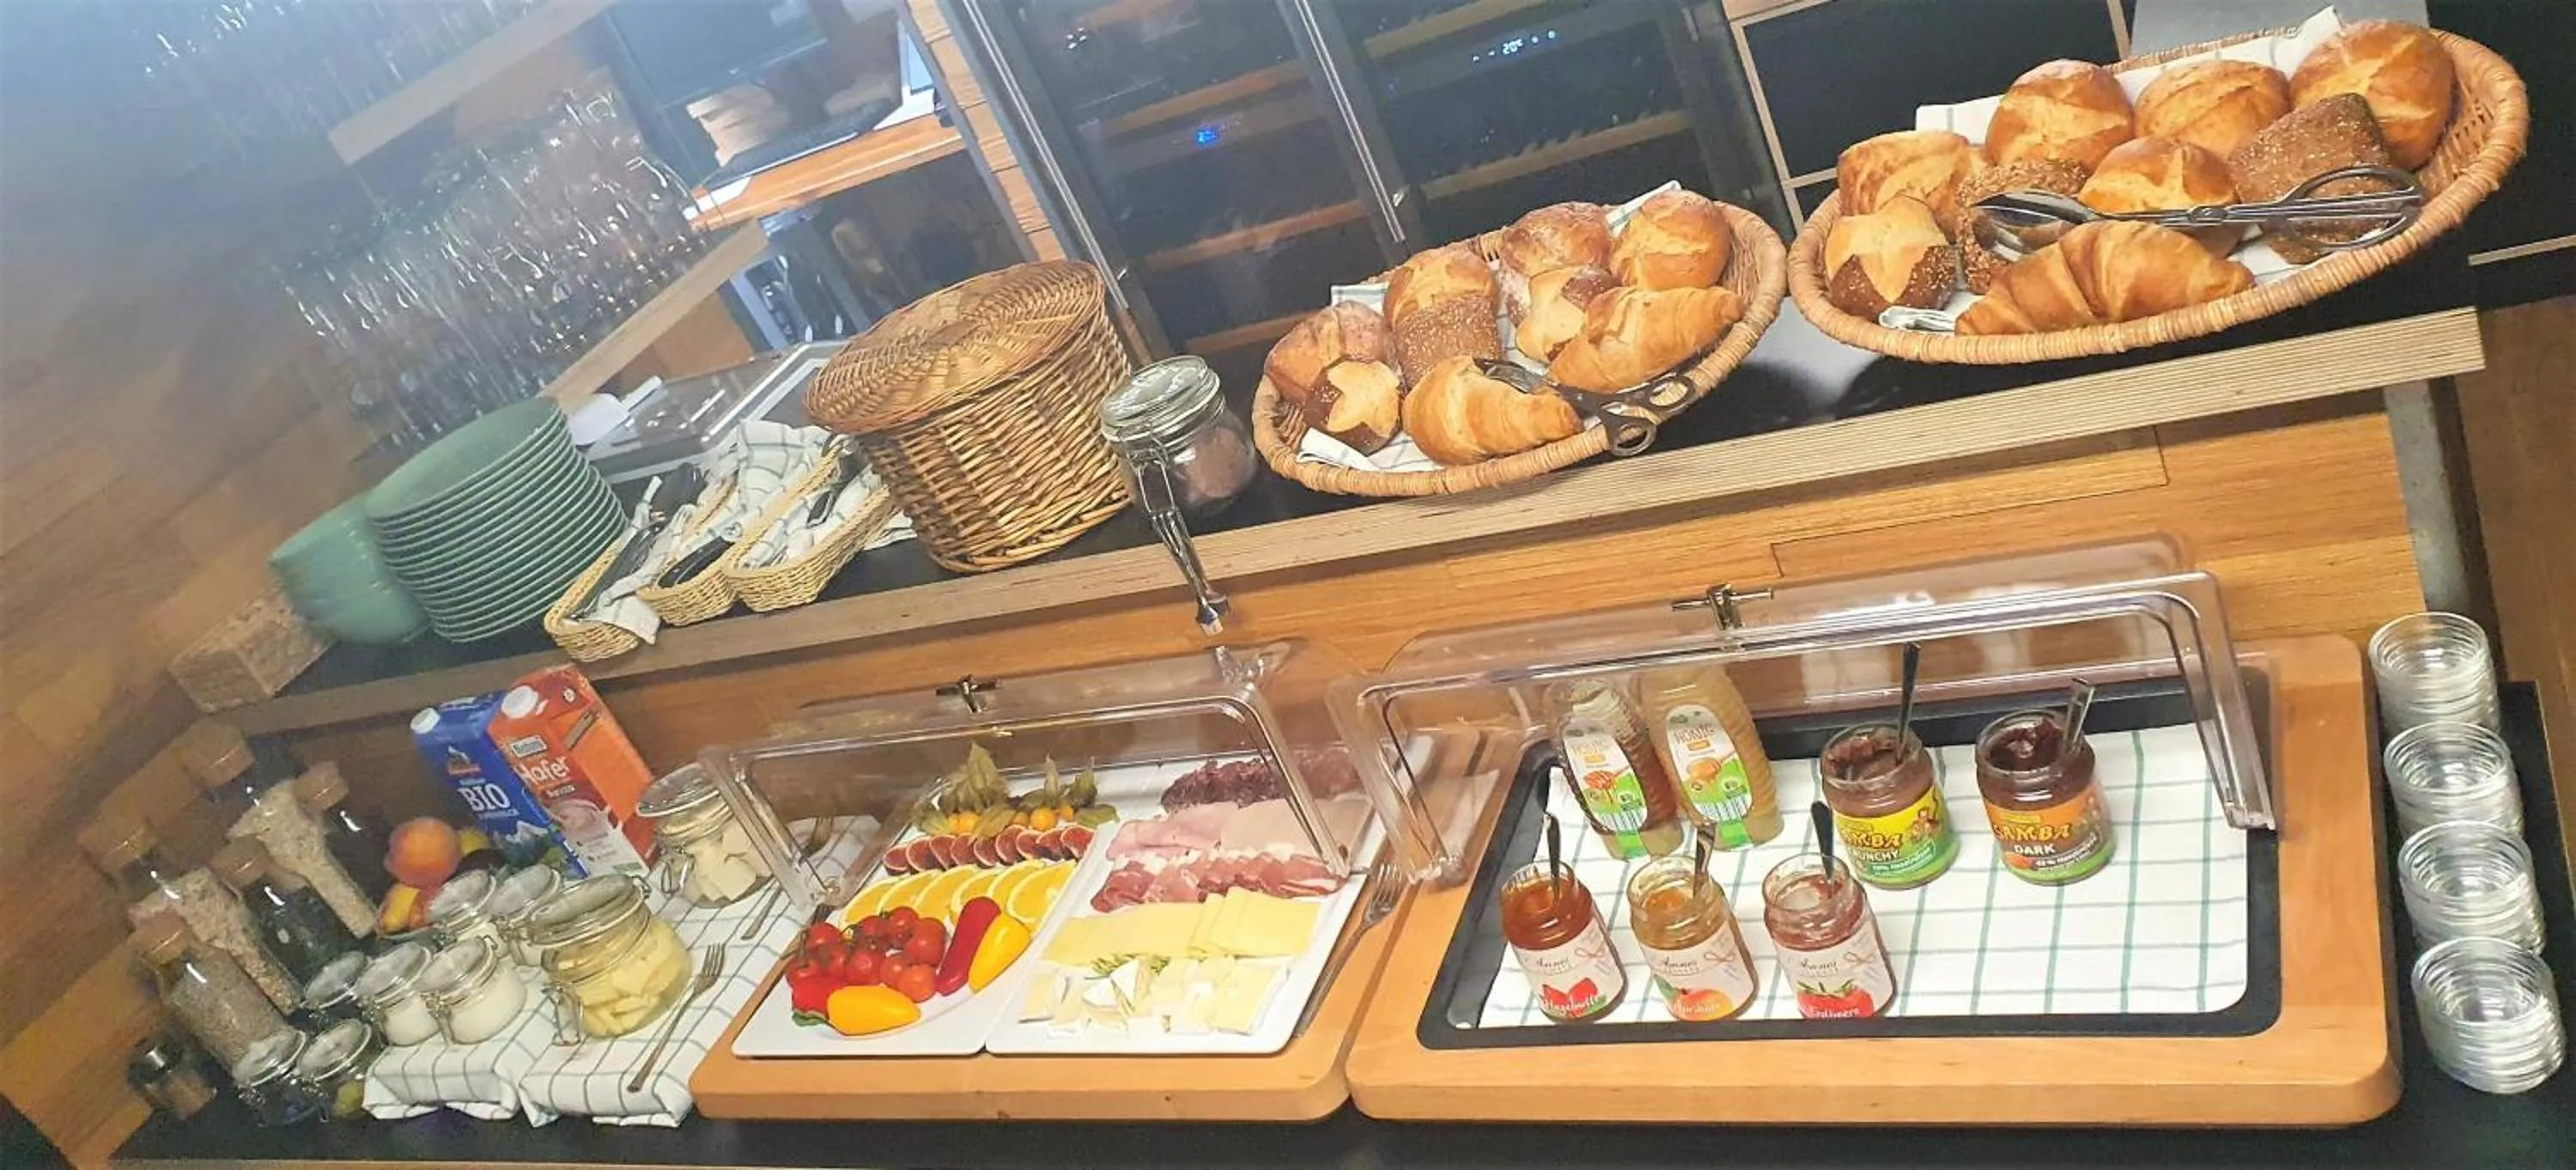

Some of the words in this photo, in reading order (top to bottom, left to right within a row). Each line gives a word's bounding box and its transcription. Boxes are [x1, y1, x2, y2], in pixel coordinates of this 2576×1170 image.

[513, 756, 570, 788] Hafer
[457, 783, 512, 812] BIO
[1992, 823, 2072, 842] SAMBA
[2014, 843, 2057, 855] DARK
